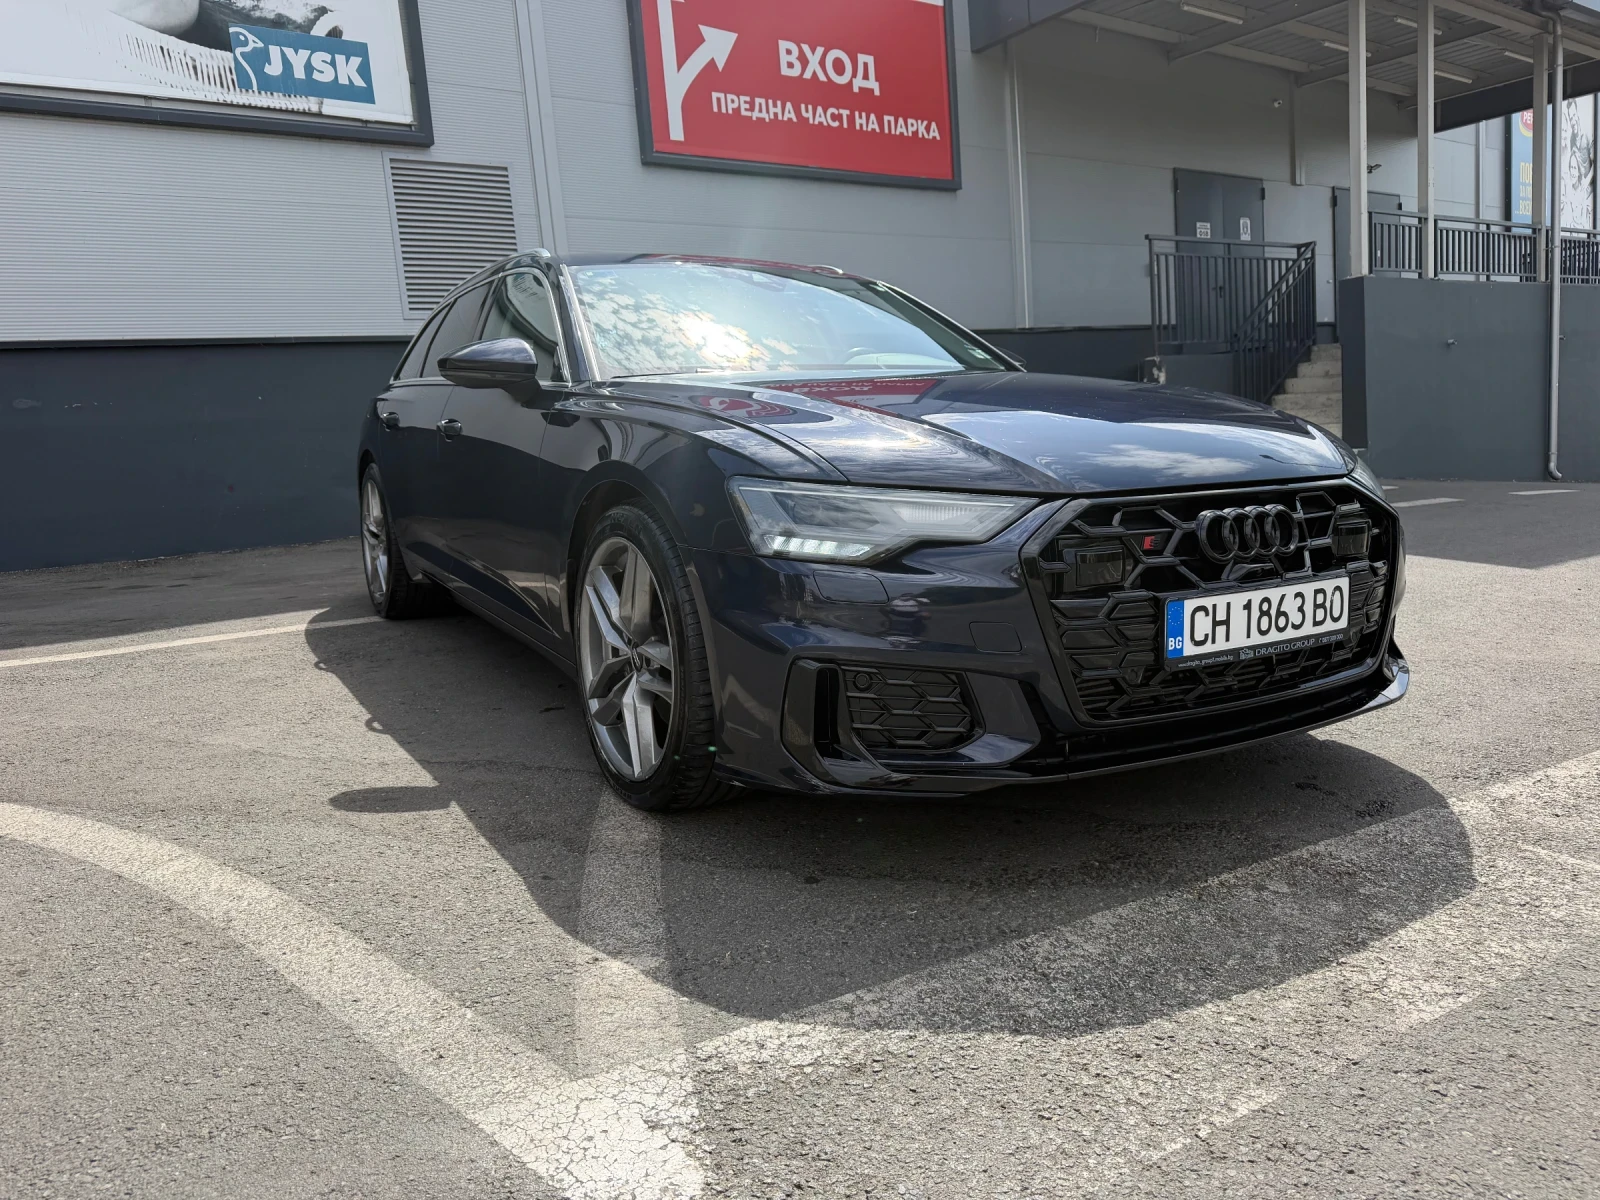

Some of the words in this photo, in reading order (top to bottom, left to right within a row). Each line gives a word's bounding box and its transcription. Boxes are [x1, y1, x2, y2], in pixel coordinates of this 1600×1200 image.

[264, 45, 367, 87] JYSK
[778, 39, 880, 96] ВХОД
[711, 91, 797, 122] ПРЕДНА
[800, 103, 850, 128] ЧАСТ
[855, 111, 880, 133] НА
[883, 115, 941, 140] ПАРКА
[1190, 601, 1231, 647] CH
[1243, 591, 1306, 639] 1863
[1312, 585, 1344, 628] BO
[1168, 636, 1183, 650] BG
[1255, 643, 1290, 656] DRAGITO
[1291, 638, 1315, 650] GROUP
